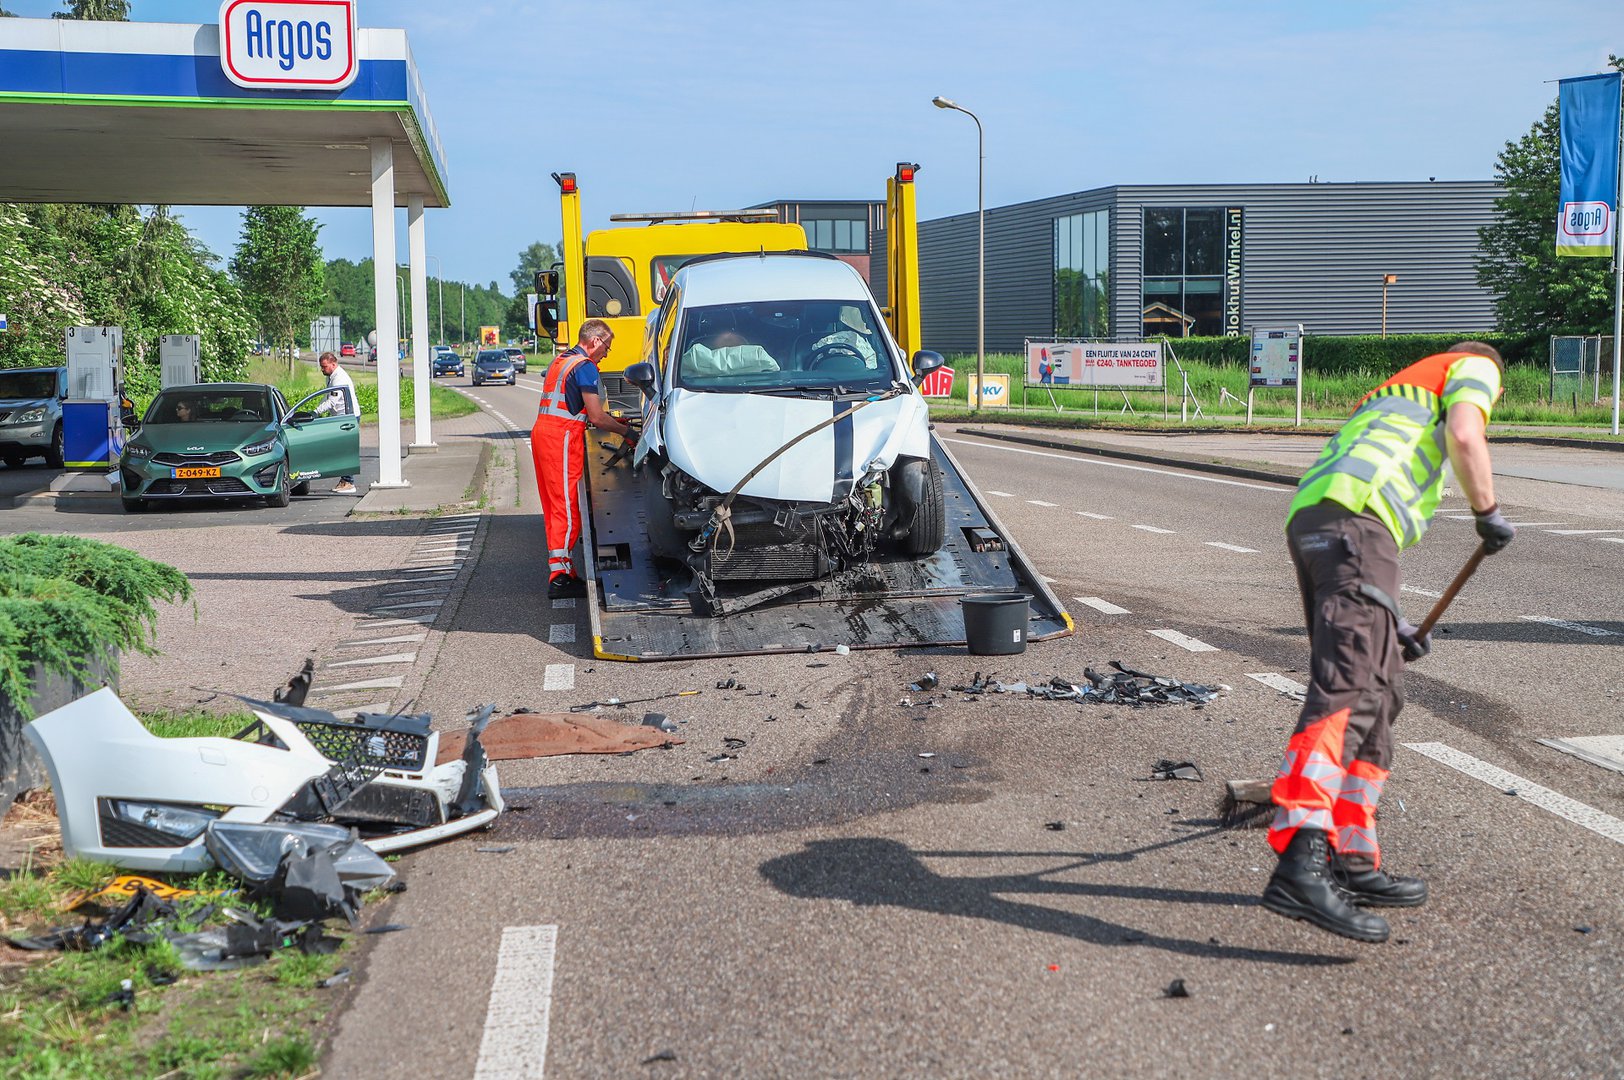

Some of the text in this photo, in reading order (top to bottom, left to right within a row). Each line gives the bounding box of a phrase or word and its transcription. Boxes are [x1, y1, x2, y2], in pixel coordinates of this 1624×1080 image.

[246, 9, 332, 71] Argos
[1227, 209, 1241, 338] BlokhutWinkel.nl
[69, 327, 75, 337] 3
[101, 327, 107, 337] 4
[1085, 350, 1157, 358] EEN FLUITJE VAN 24 CENT
[1116, 359, 1157, 367] TANKTEGOED
[178, 468, 218, 478] Z-049-KZ
